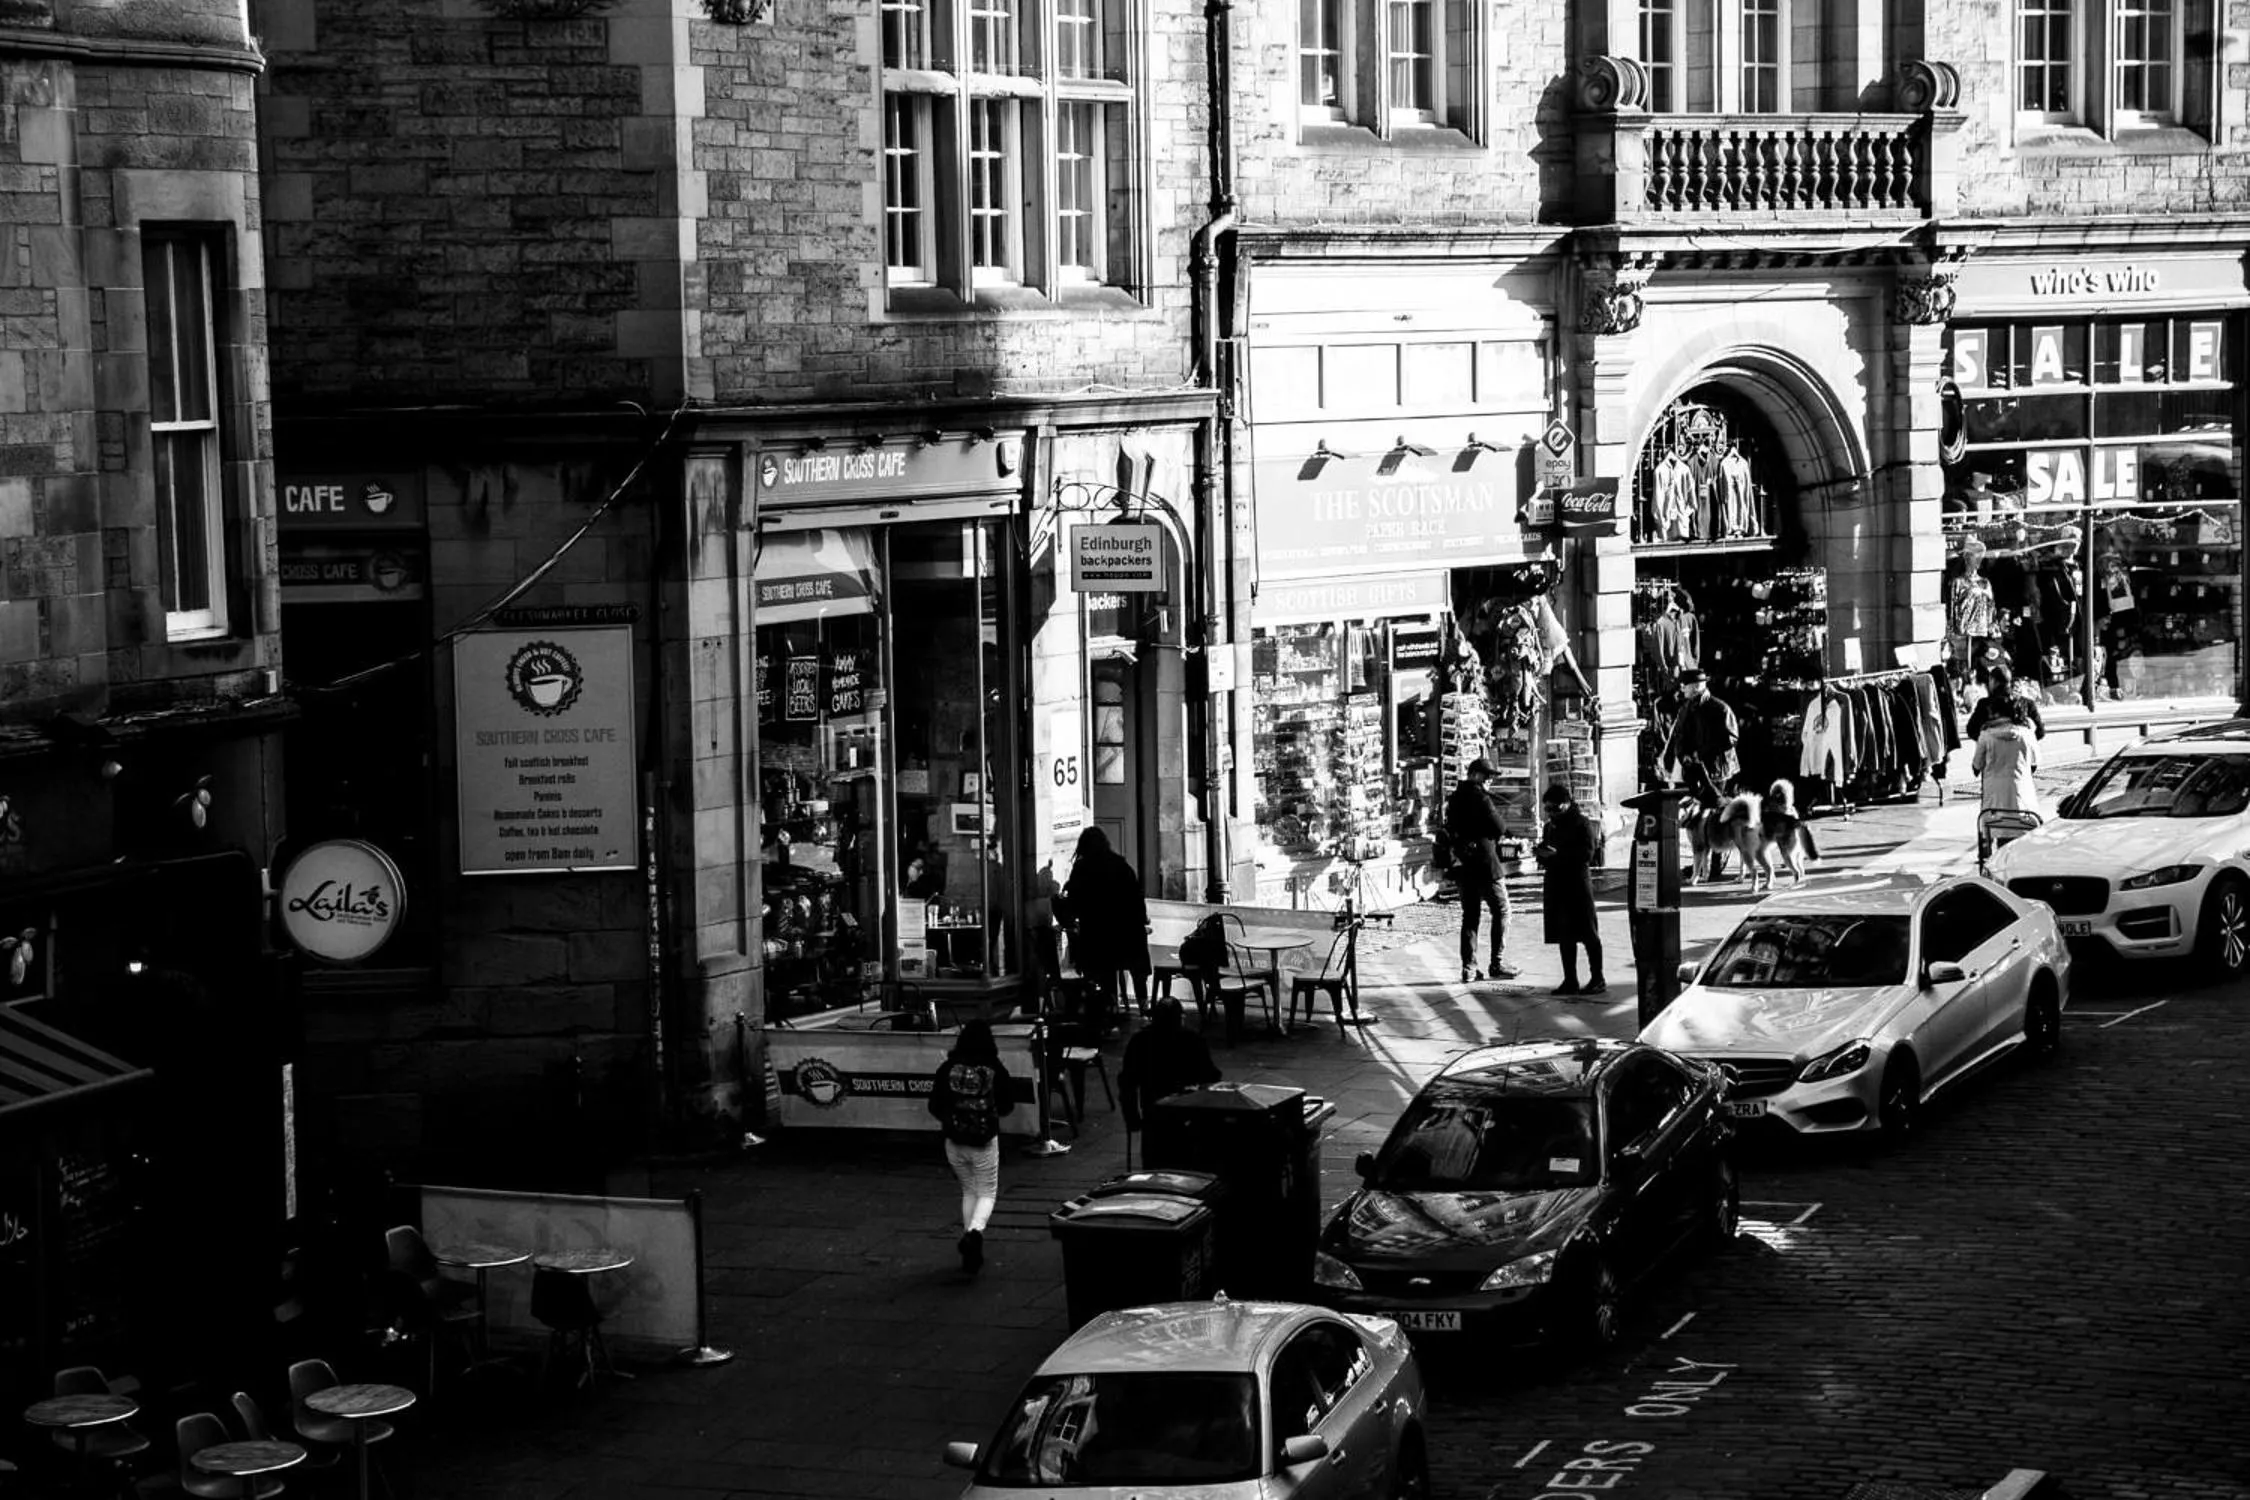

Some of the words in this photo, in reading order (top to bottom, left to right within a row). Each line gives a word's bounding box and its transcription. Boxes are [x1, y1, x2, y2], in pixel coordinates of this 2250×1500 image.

[2030, 266, 2101, 295] who's
[2106, 265, 2159, 293] who
[1953, 332, 2213, 384] SALE
[784, 455, 839, 484] SOUTHERN
[843, 453, 874, 480] CROSS
[878, 452, 906, 477] CAFE
[1546, 459, 1571, 471] epay
[2027, 452, 2137, 503] SALE
[284, 485, 346, 512] CAFE
[1311, 489, 1362, 521] THE
[1367, 481, 1495, 518] SCOTSMAN
[1080, 536, 1152, 553] Edinburgh
[280, 563, 320, 580] CROSS
[322, 563, 360, 580] CAFE
[1080, 555, 1152, 568] backpackers
[761, 582, 794, 601] SOUTHERN
[796, 581, 814, 598] CROSS
[815, 580, 833, 596] CAFE
[1274, 587, 1358, 612] SCOTTISH
[1368, 582, 1417, 605] GIFTS
[475, 729, 539, 746] SOUTHERN
[544, 728, 579, 744] CROSS
[583, 727, 617, 743] CAFE
[1054, 755, 1078, 787] 65
[1643, 815, 1657, 837] P
[505, 850, 525, 862] open
[527, 848, 550, 861] from
[573, 846, 595, 861] daily
[852, 1078, 905, 1092] SOUTHERN
[1425, 1312, 1455, 1328] FKY
[1623, 1356, 1740, 1417] ONLY
